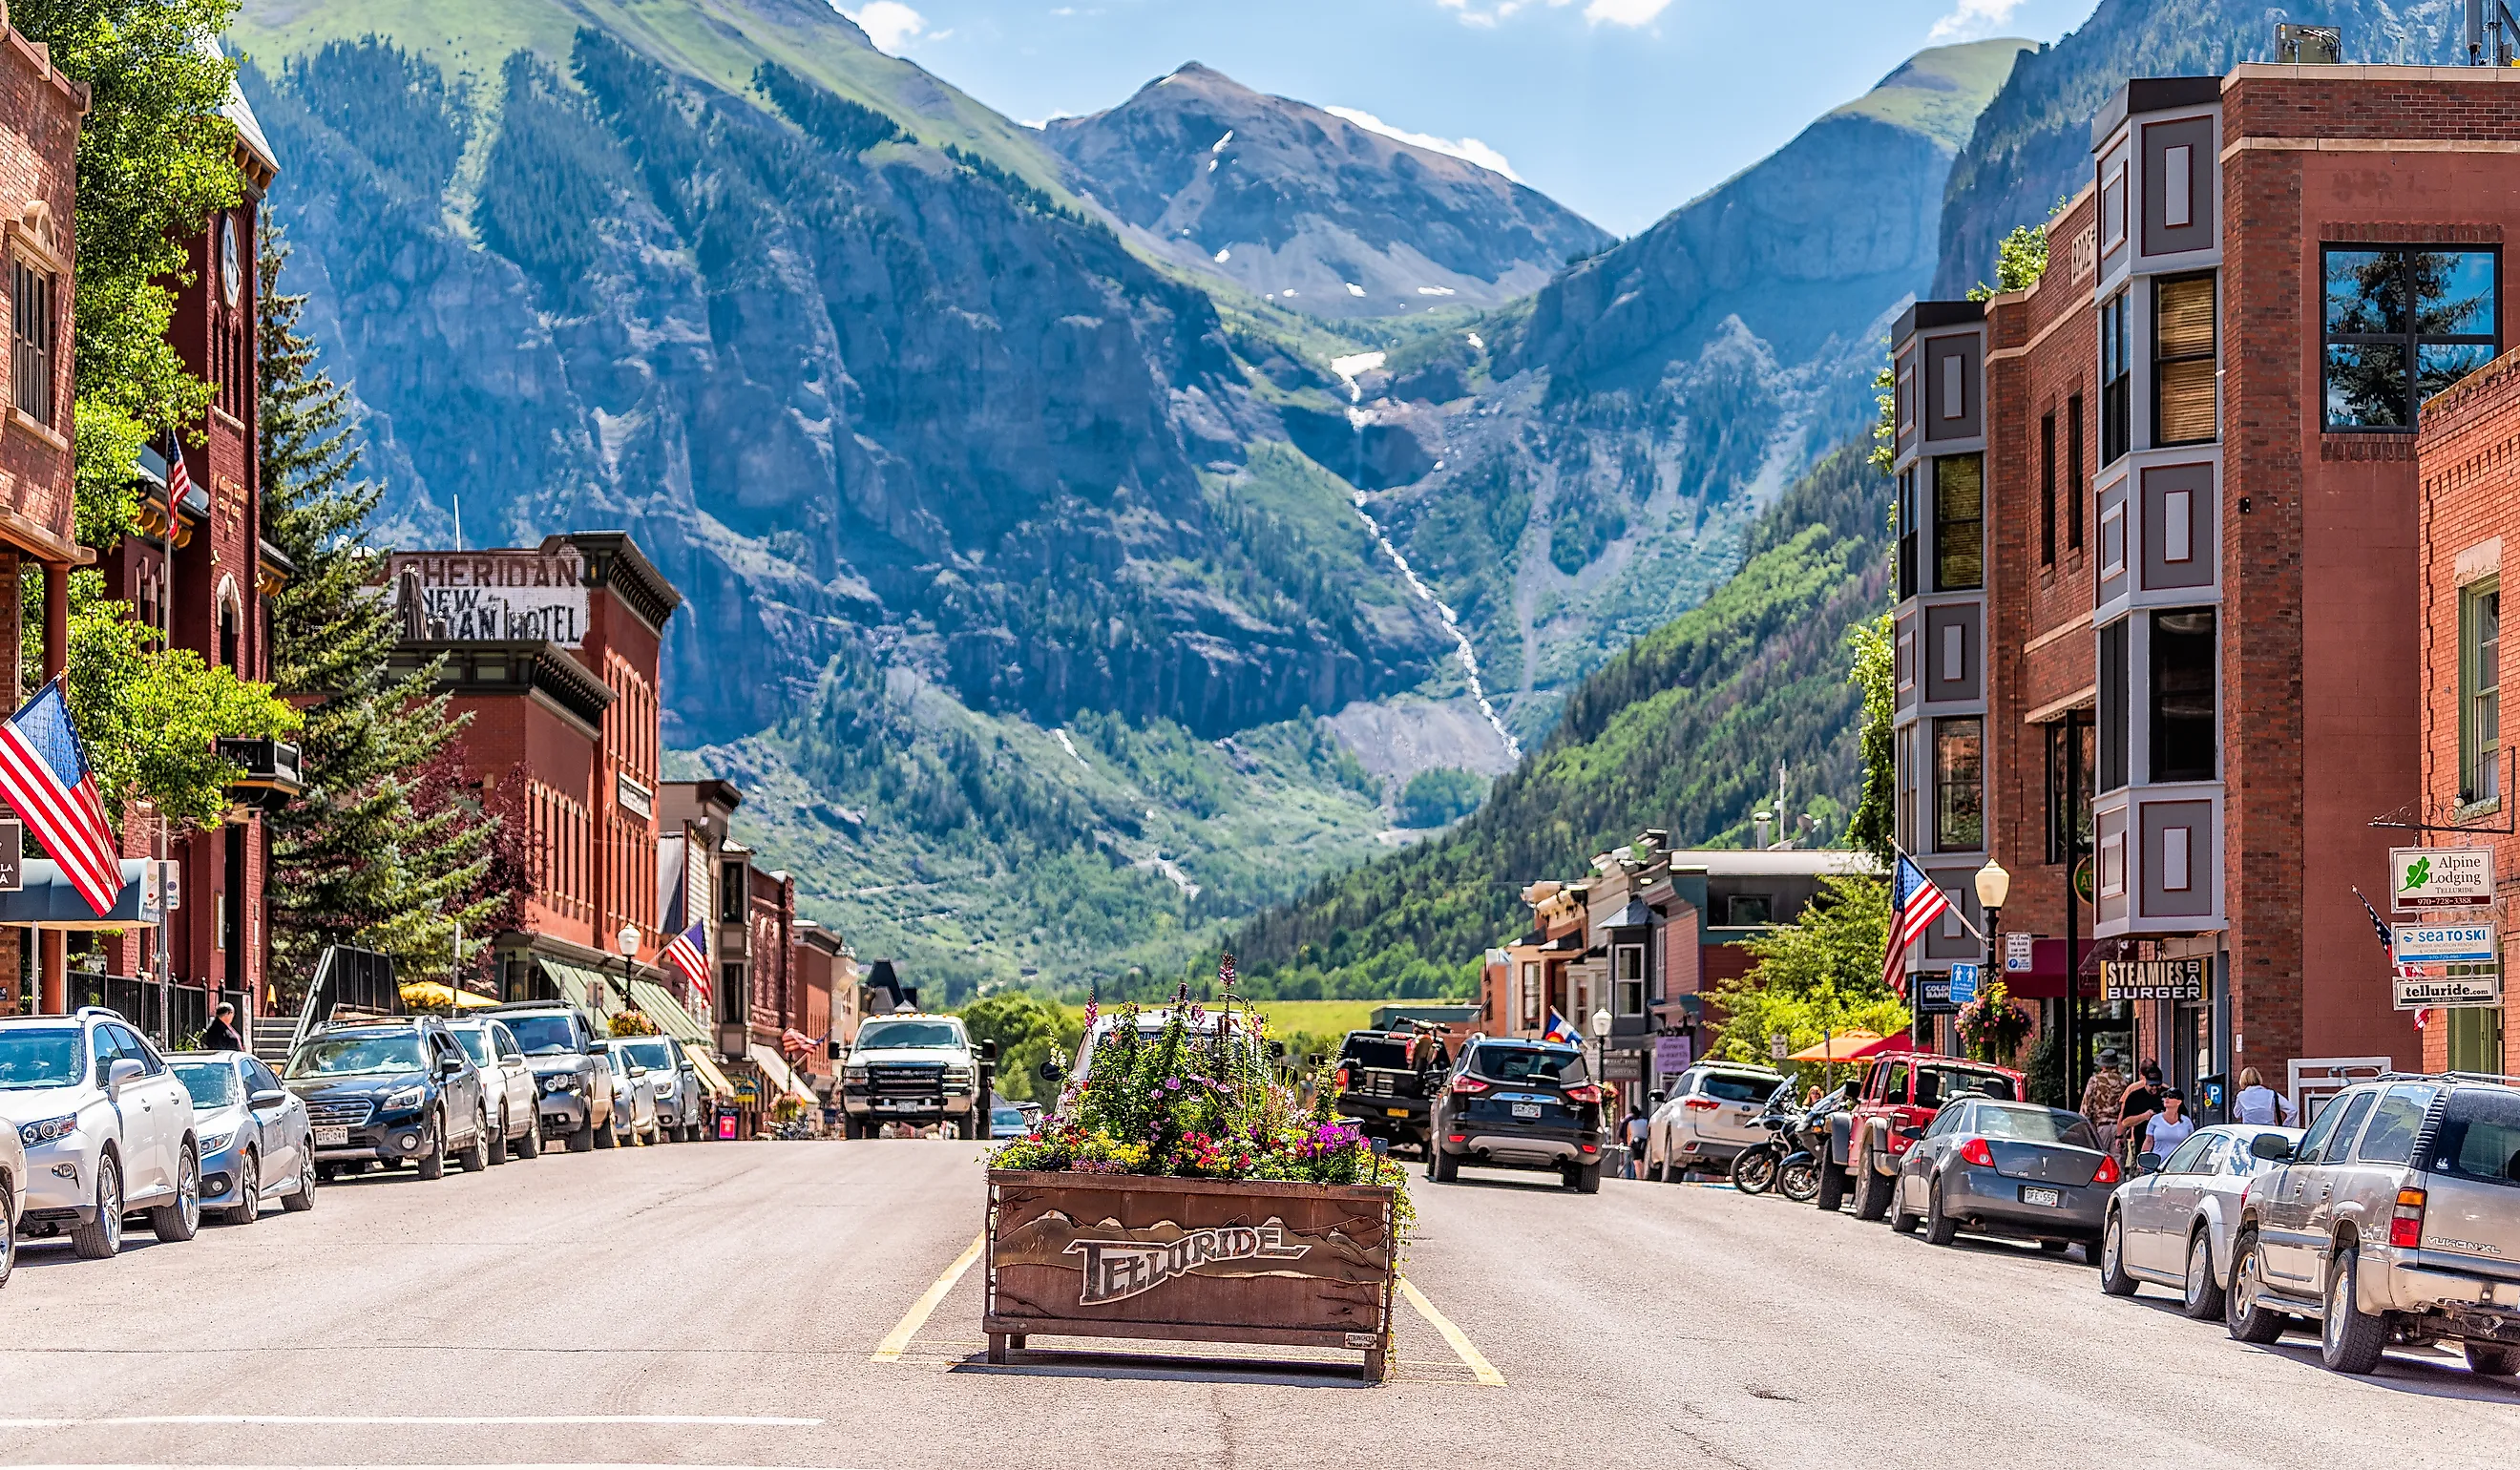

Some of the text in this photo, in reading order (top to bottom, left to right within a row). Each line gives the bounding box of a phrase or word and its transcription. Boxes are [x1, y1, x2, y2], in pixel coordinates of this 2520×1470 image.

[421, 589, 480, 613] NEW
[509, 604, 579, 642] HOTEL
[2438, 855, 2481, 871] Alpine
[2429, 871, 2482, 886] Lodging
[2417, 897, 2472, 906] 970-728-3388
[2446, 930, 2463, 941] TO
[2466, 929, 2487, 941] SKI
[2107, 961, 2185, 987] STEAMIES
[2108, 987, 2186, 999] BURGER
[2404, 983, 2489, 998] telluride.com
[2426, 1236, 2502, 1254] YUKON XL
